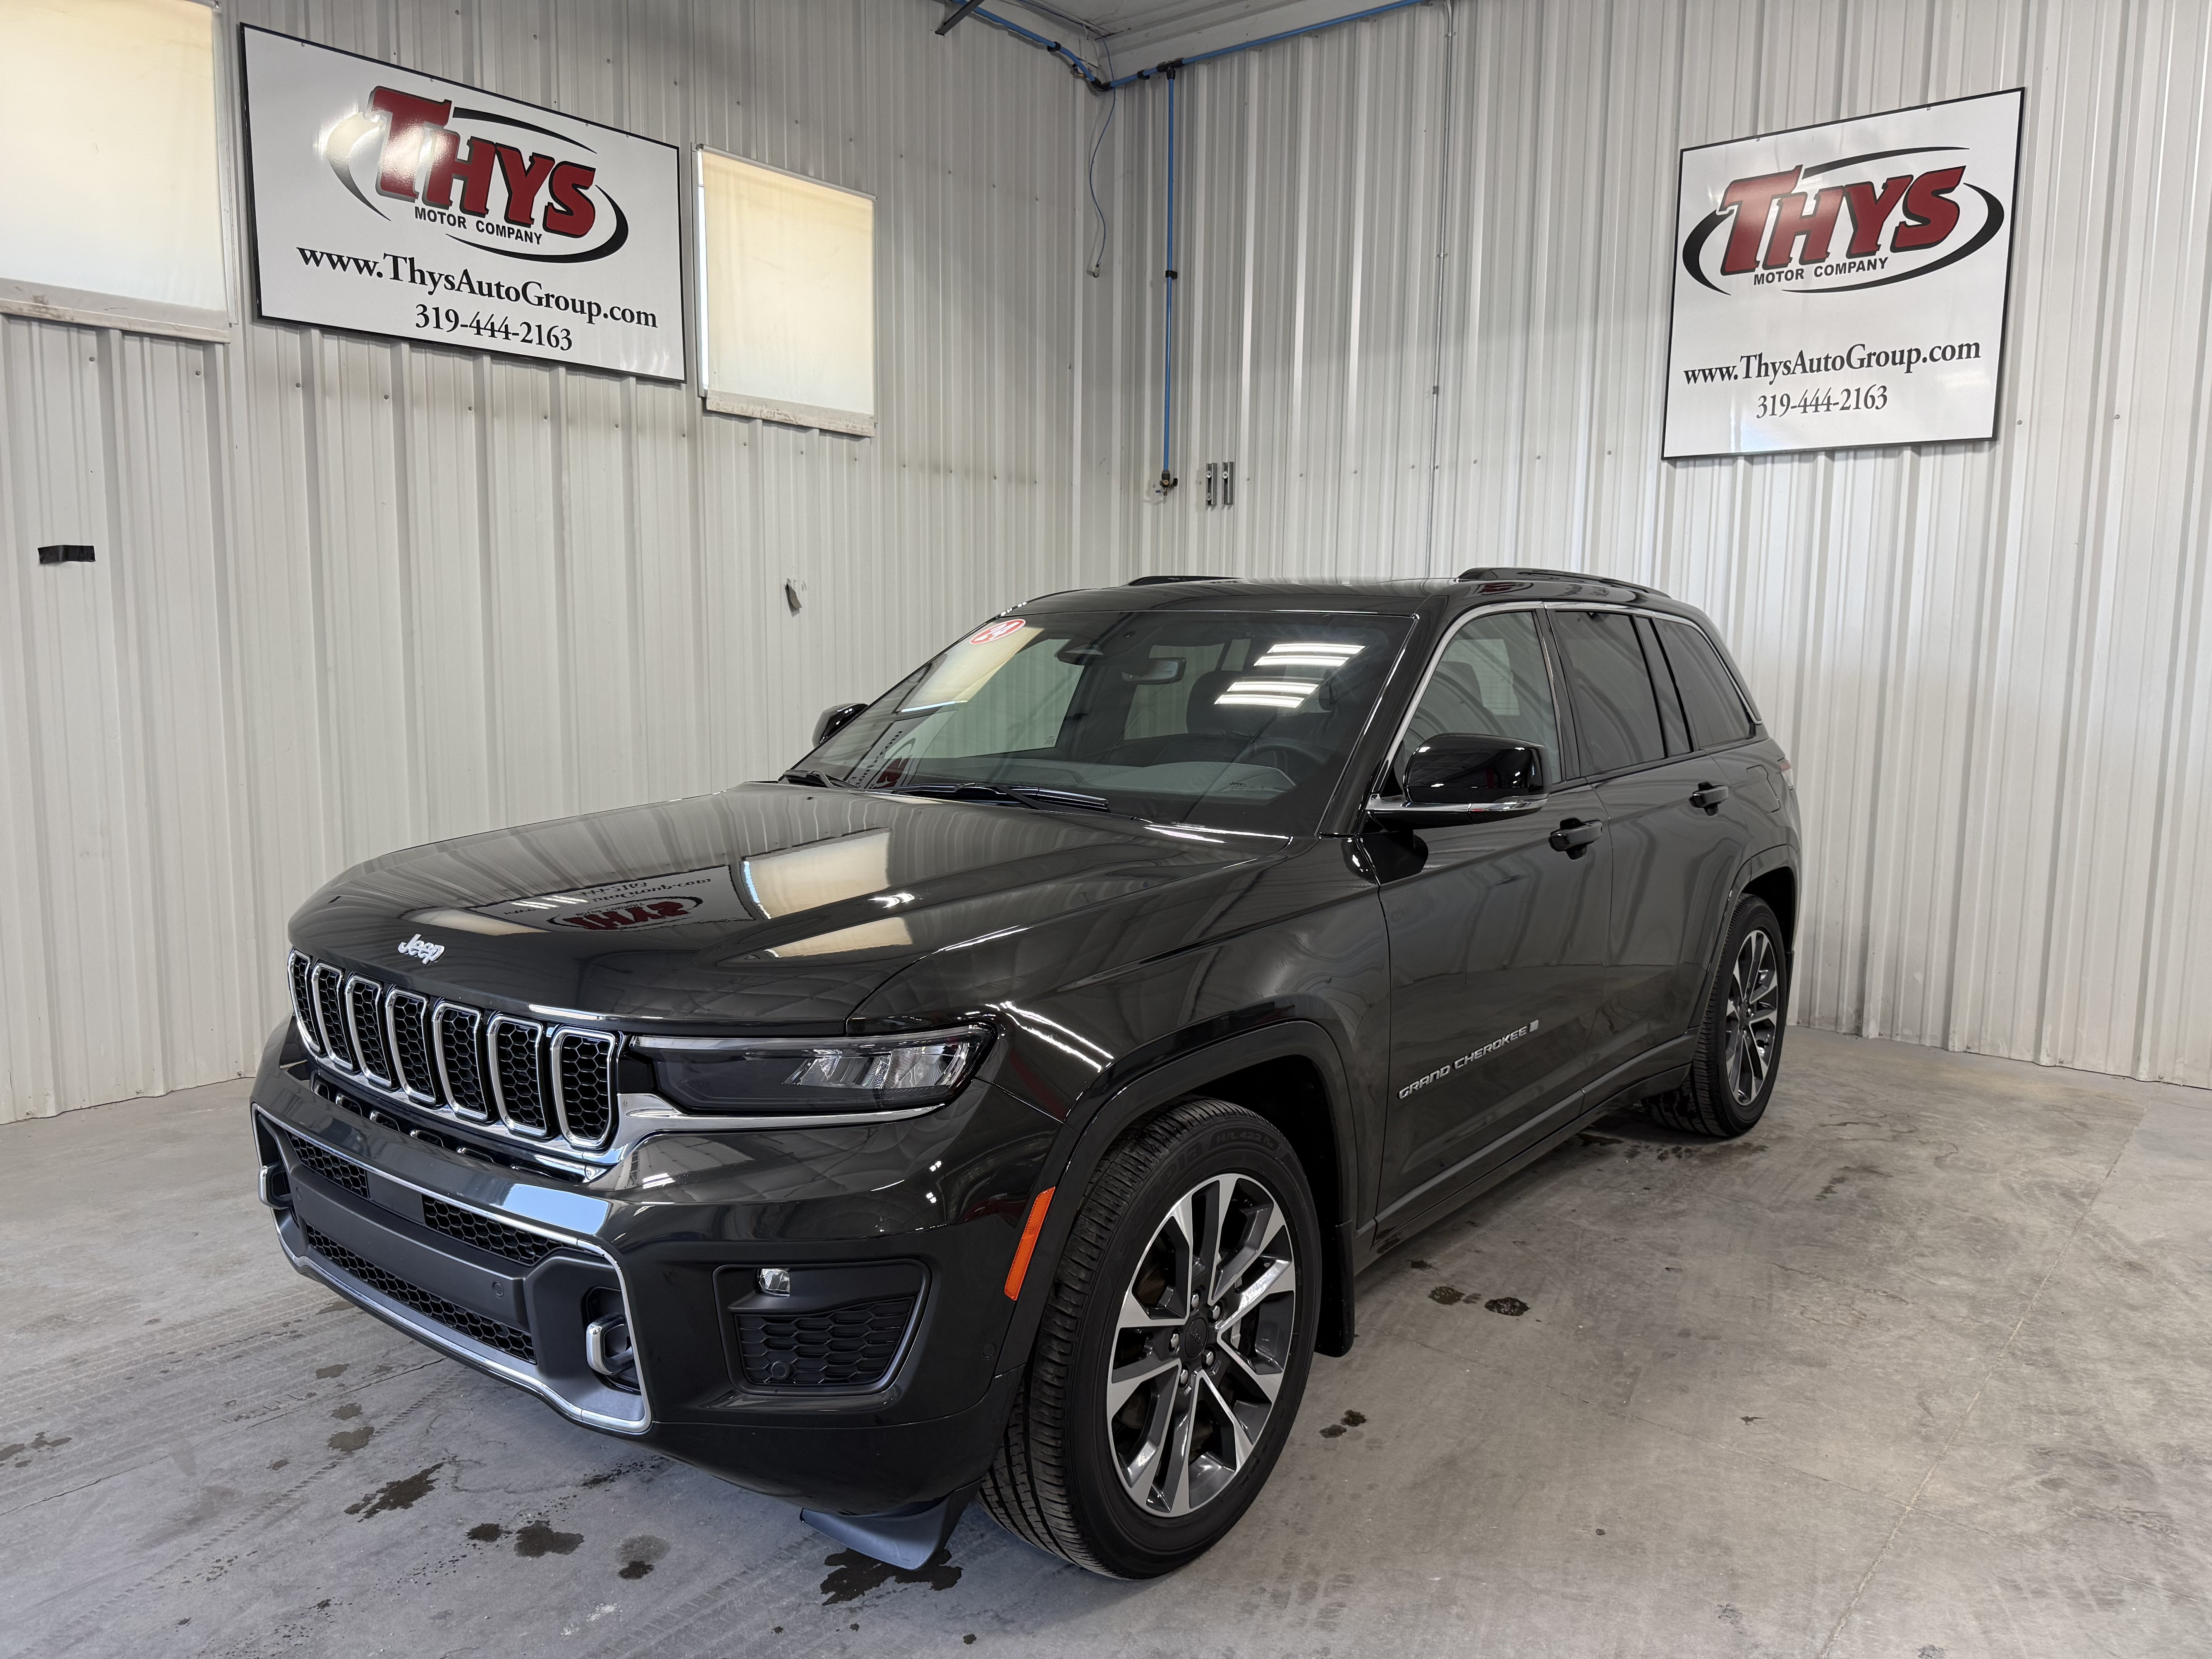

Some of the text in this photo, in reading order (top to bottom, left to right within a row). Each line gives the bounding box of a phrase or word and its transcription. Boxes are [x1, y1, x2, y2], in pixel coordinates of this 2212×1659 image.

[368, 86, 596, 238] THYS
[414, 206, 542, 245] MOTOR COMPANY
[1717, 164, 1966, 276] THYS
[297, 247, 658, 328] www.ThysAutoGroup.com
[1753, 257, 1889, 286] MOTOR COMPANY
[415, 304, 573, 351] 319-444-2163
[1683, 341, 1981, 385] www.ThysAutoGroup.com
[1756, 384, 1888, 418] 319-444-2163
[398, 934, 445, 964] Jeep
[1398, 1025, 1527, 1099] GRAND CHEROKEE
[1239, 1130, 1262, 1142] 422
